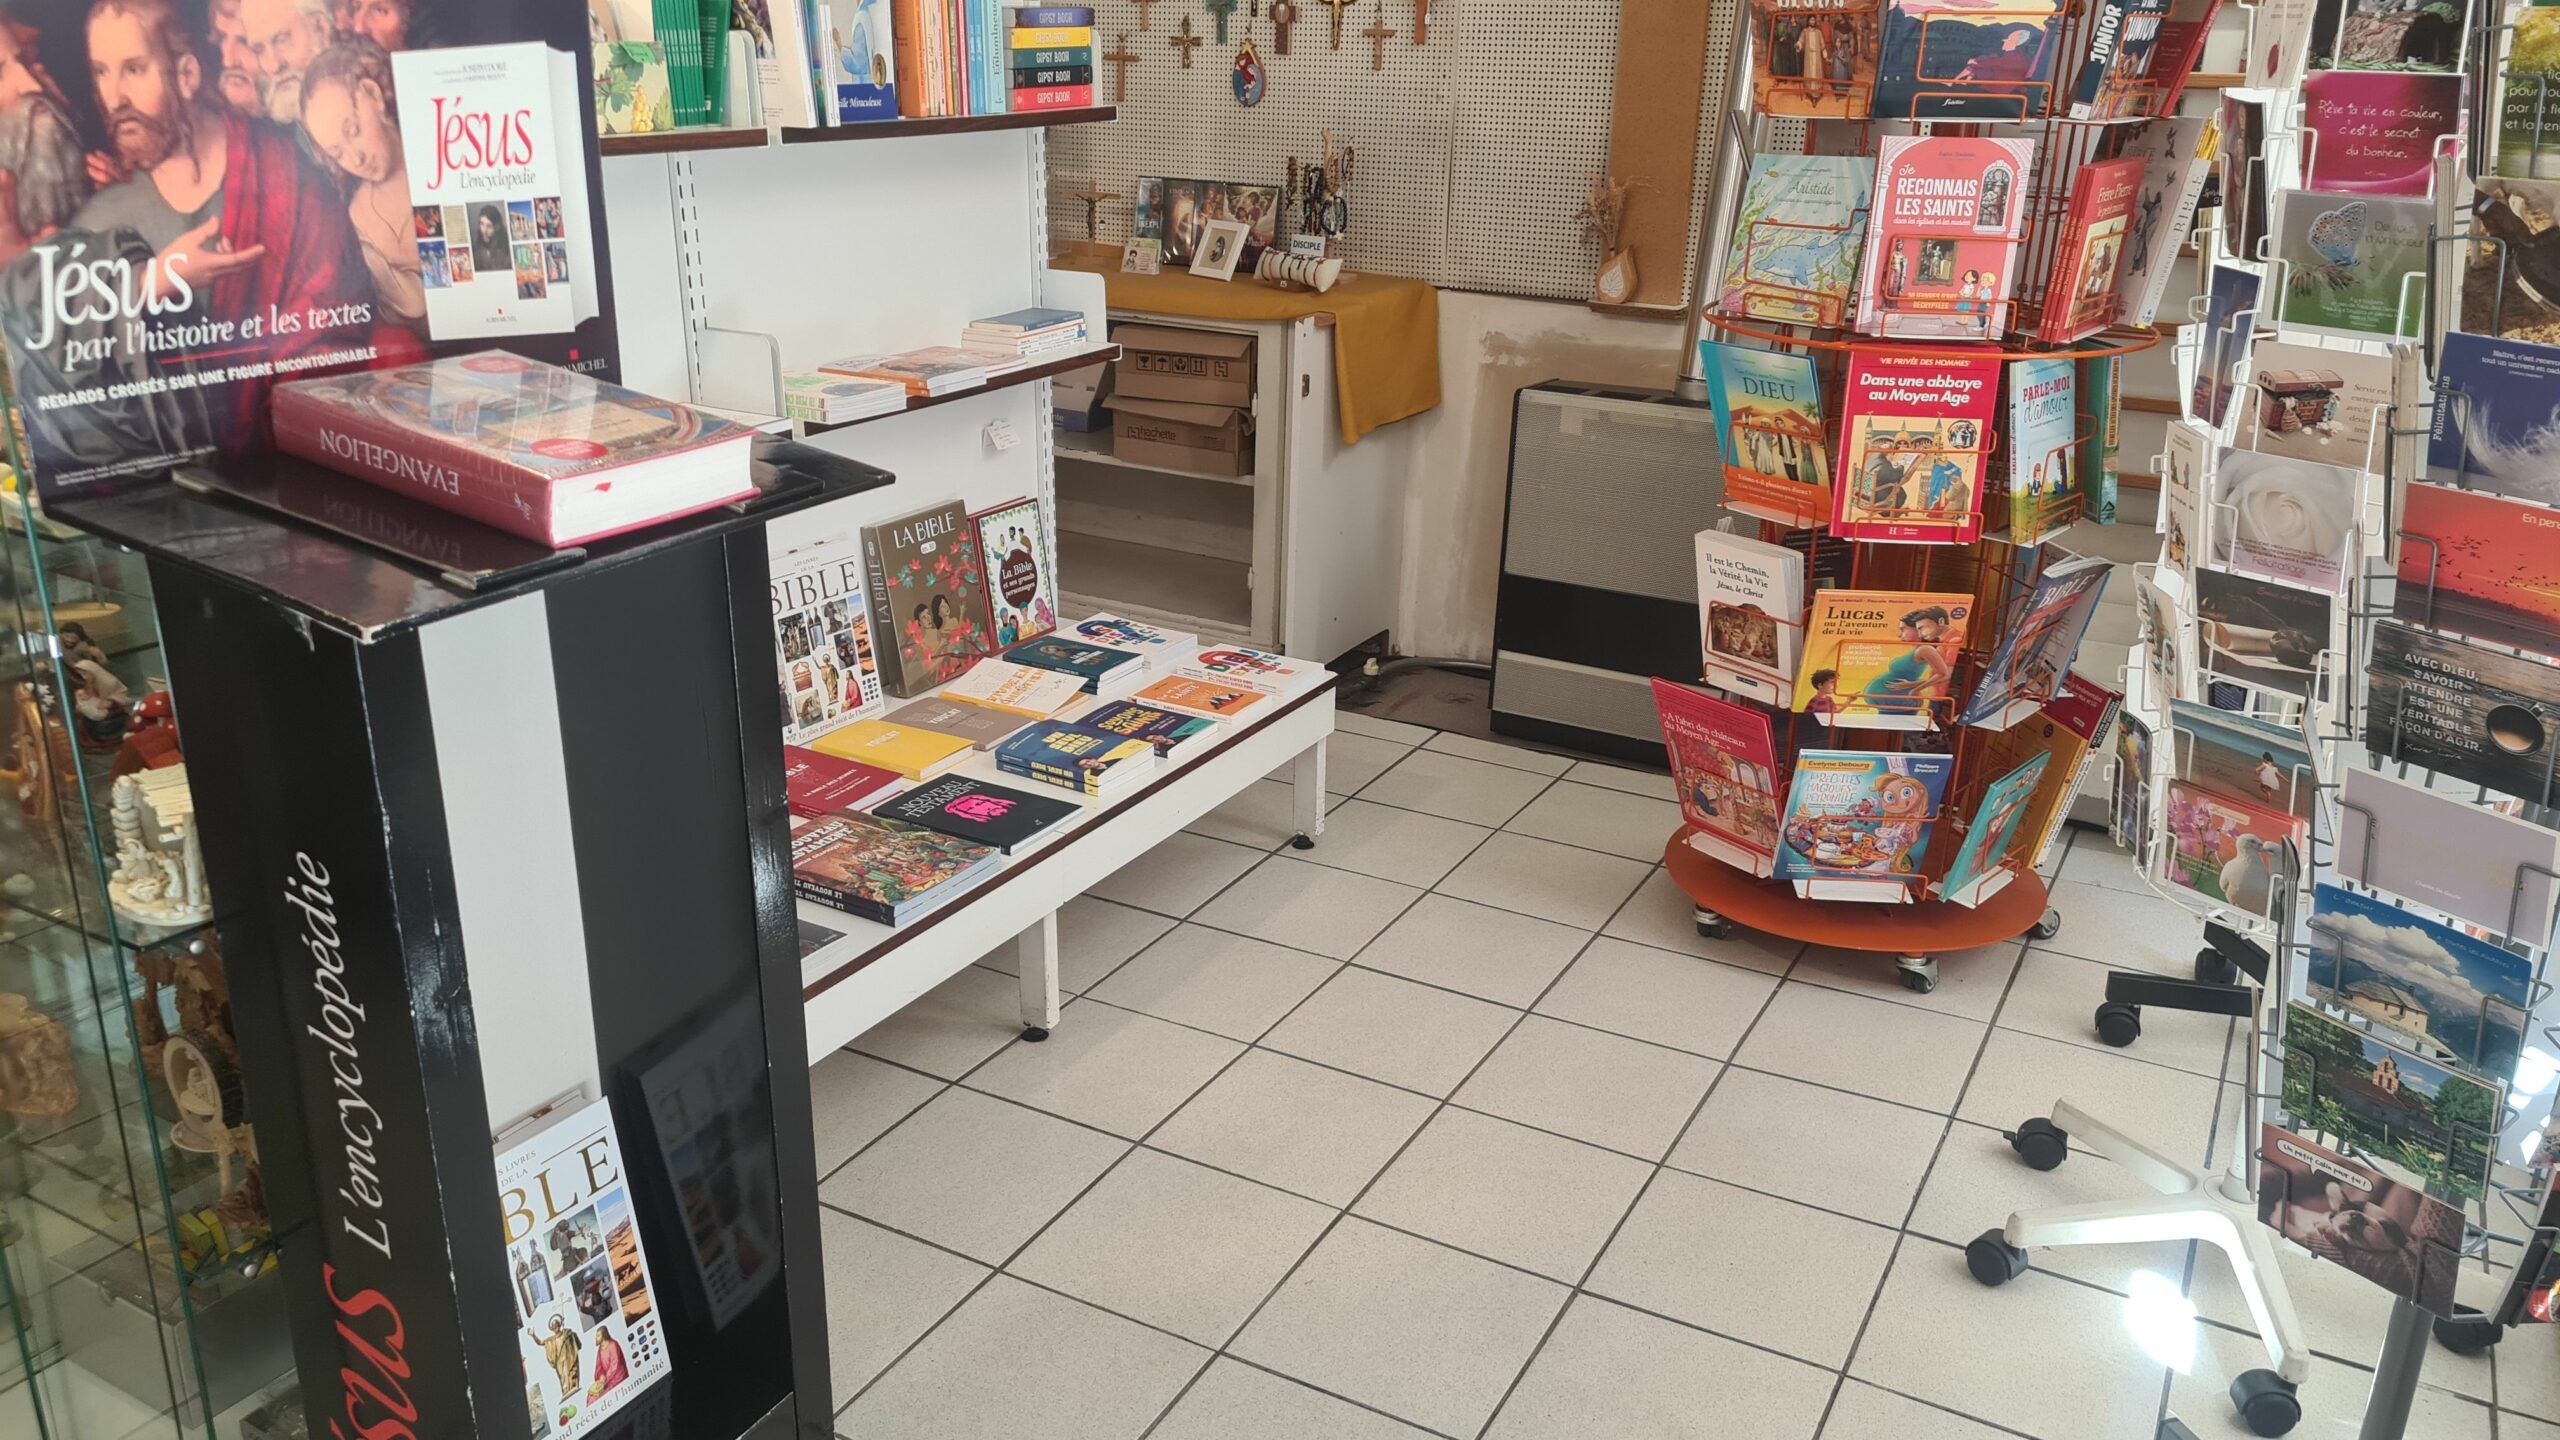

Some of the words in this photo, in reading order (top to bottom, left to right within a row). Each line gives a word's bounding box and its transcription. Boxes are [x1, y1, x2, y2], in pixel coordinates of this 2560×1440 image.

[2090, 4, 2122, 64] JUNIOR
[1036, 52, 1053, 63] GIPSY
[1037, 72, 1055, 83] GIPSY
[1037, 92, 1055, 104] GIPSY
[2509, 88, 2538, 98] pour
[2318, 100, 2343, 118] Rêve
[2347, 103, 2359, 114] ta
[2363, 105, 2376, 115] vie
[2382, 108, 2395, 117] en
[2400, 105, 2443, 121] couleur,
[2507, 104, 2529, 114] par
[2369, 124, 2378, 136] le
[2384, 127, 2420, 138] secret
[2505, 119, 2518, 129] et
[2522, 118, 2535, 130] la
[427, 96, 536, 190] Jésus
[2345, 144, 2359, 156] du
[2363, 144, 2408, 158] bonheur.
[459, 168, 536, 191] L'encyclopédie
[1788, 181, 1834, 196] Aristide
[1896, 177, 1978, 197] RECONNAIS
[1895, 198, 1921, 215] LES
[1923, 199, 1975, 217] SAINTS
[1293, 240, 1321, 251] DISCIPLE
[25, 243, 193, 350] Jésus
[64, 334, 118, 373] par
[125, 317, 235, 355] l'histoire
[240, 314, 262, 338] et
[270, 303, 301, 335] les
[308, 302, 372, 330] textes
[1894, 356, 1919, 366] PRIVÉE
[38, 387, 107, 410] REGARDS
[108, 376, 167, 401] CROISÉS
[169, 373, 197, 391] SUR
[200, 368, 225, 387] UNE
[227, 361, 275, 382] FIGURE
[275, 346, 378, 373] INCONTOURNABLE
[1742, 376, 1795, 402] DIEU
[1860, 373, 1896, 388] Dans
[1898, 376, 1924, 388] une
[1927, 374, 1982, 392] abbaye
[2023, 376, 2071, 402] PARLE-MOI
[1869, 390, 1887, 401] au
[1889, 389, 1939, 406] Moyen
[1940, 391, 1970, 407] Age
[2023, 395, 2070, 424] d'amour
[320, 427, 460, 497] EVANGELION
[2523, 513, 2537, 524] En
[893, 527, 914, 549] LA
[915, 511, 956, 542] BIBLE
[1002, 568, 1012, 579] La
[1013, 561, 1033, 576] Bible
[1706, 553, 1713, 562] Il
[1714, 557, 1724, 566] est
[1726, 558, 1733, 568] le
[1735, 562, 1769, 578] Chemin,
[869, 559, 889, 602] BIBLE
[1709, 566, 1716, 575] la
[1718, 567, 1744, 582] Vérité,
[1745, 575, 1753, 584] la
[1754, 577, 1768, 588] Vie
[770, 561, 860, 616] BIBLE
[1005, 581, 1035, 599] personnages
[1736, 585, 1742, 593] le
[1743, 587, 1764, 598] Christ
[2040, 574, 2096, 609] BIBLE
[876, 603, 891, 623] LA
[1825, 606, 1885, 620] Lucas
[1839, 620, 1888, 628] l'aventure
[2404, 653, 2438, 669] AVEC
[2442, 663, 2479, 682] DIEU,
[1975, 687, 1984, 698] LA
[1981, 671, 1993, 690] BIBLE
[2414, 669, 2464, 691] SAVOIR
[2404, 681, 2472, 707] ATTENDRE
[2409, 696, 2432, 709] EST
[2437, 703, 2464, 719] UNE
[799, 731, 806, 739] Le
[806, 726, 819, 738] plus
[820, 720, 835, 733] grand
[836, 713, 848, 726] récit
[849, 711, 855, 720] de
[855, 703, 882, 718] l'humanité
[1664, 721, 1674, 730] du
[1676, 725, 1703, 741] Moyen
[2400, 707, 2472, 735] VÉRITABLE
[1041, 731, 1066, 743] UN
[1049, 733, 1082, 749] SEUL
[1062, 735, 1093, 754] DIEU
[1696, 722, 1709, 735] des
[1711, 729, 1747, 748] châteaux
[2389, 717, 2431, 736] FAÇON
[2434, 731, 2483, 752] D'AGIR.
[1808, 760, 1837, 768] Evelyne
[1838, 761, 1870, 769] Debourg
[898, 780, 962, 811] NOUVEAU
[905, 781, 981, 818] TESTAMENT
[791, 821, 844, 849] OUVEAU
[792, 827, 854, 860] STAMENT
[284, 850, 391, 1260] L'encyclopédie
[505, 1150, 536, 1172] LIVRES
[2294, 1147, 2314, 1163] petit
[2333, 1165, 2349, 1179] pour
[501, 1175, 513, 1187] DE
[514, 1169, 528, 1181] LA
[499, 1136, 619, 1244] BLE
[574, 1407, 599, 1431] récit
[600, 1398, 614, 1412] de
[614, 1358, 665, 1402] l'humanité
